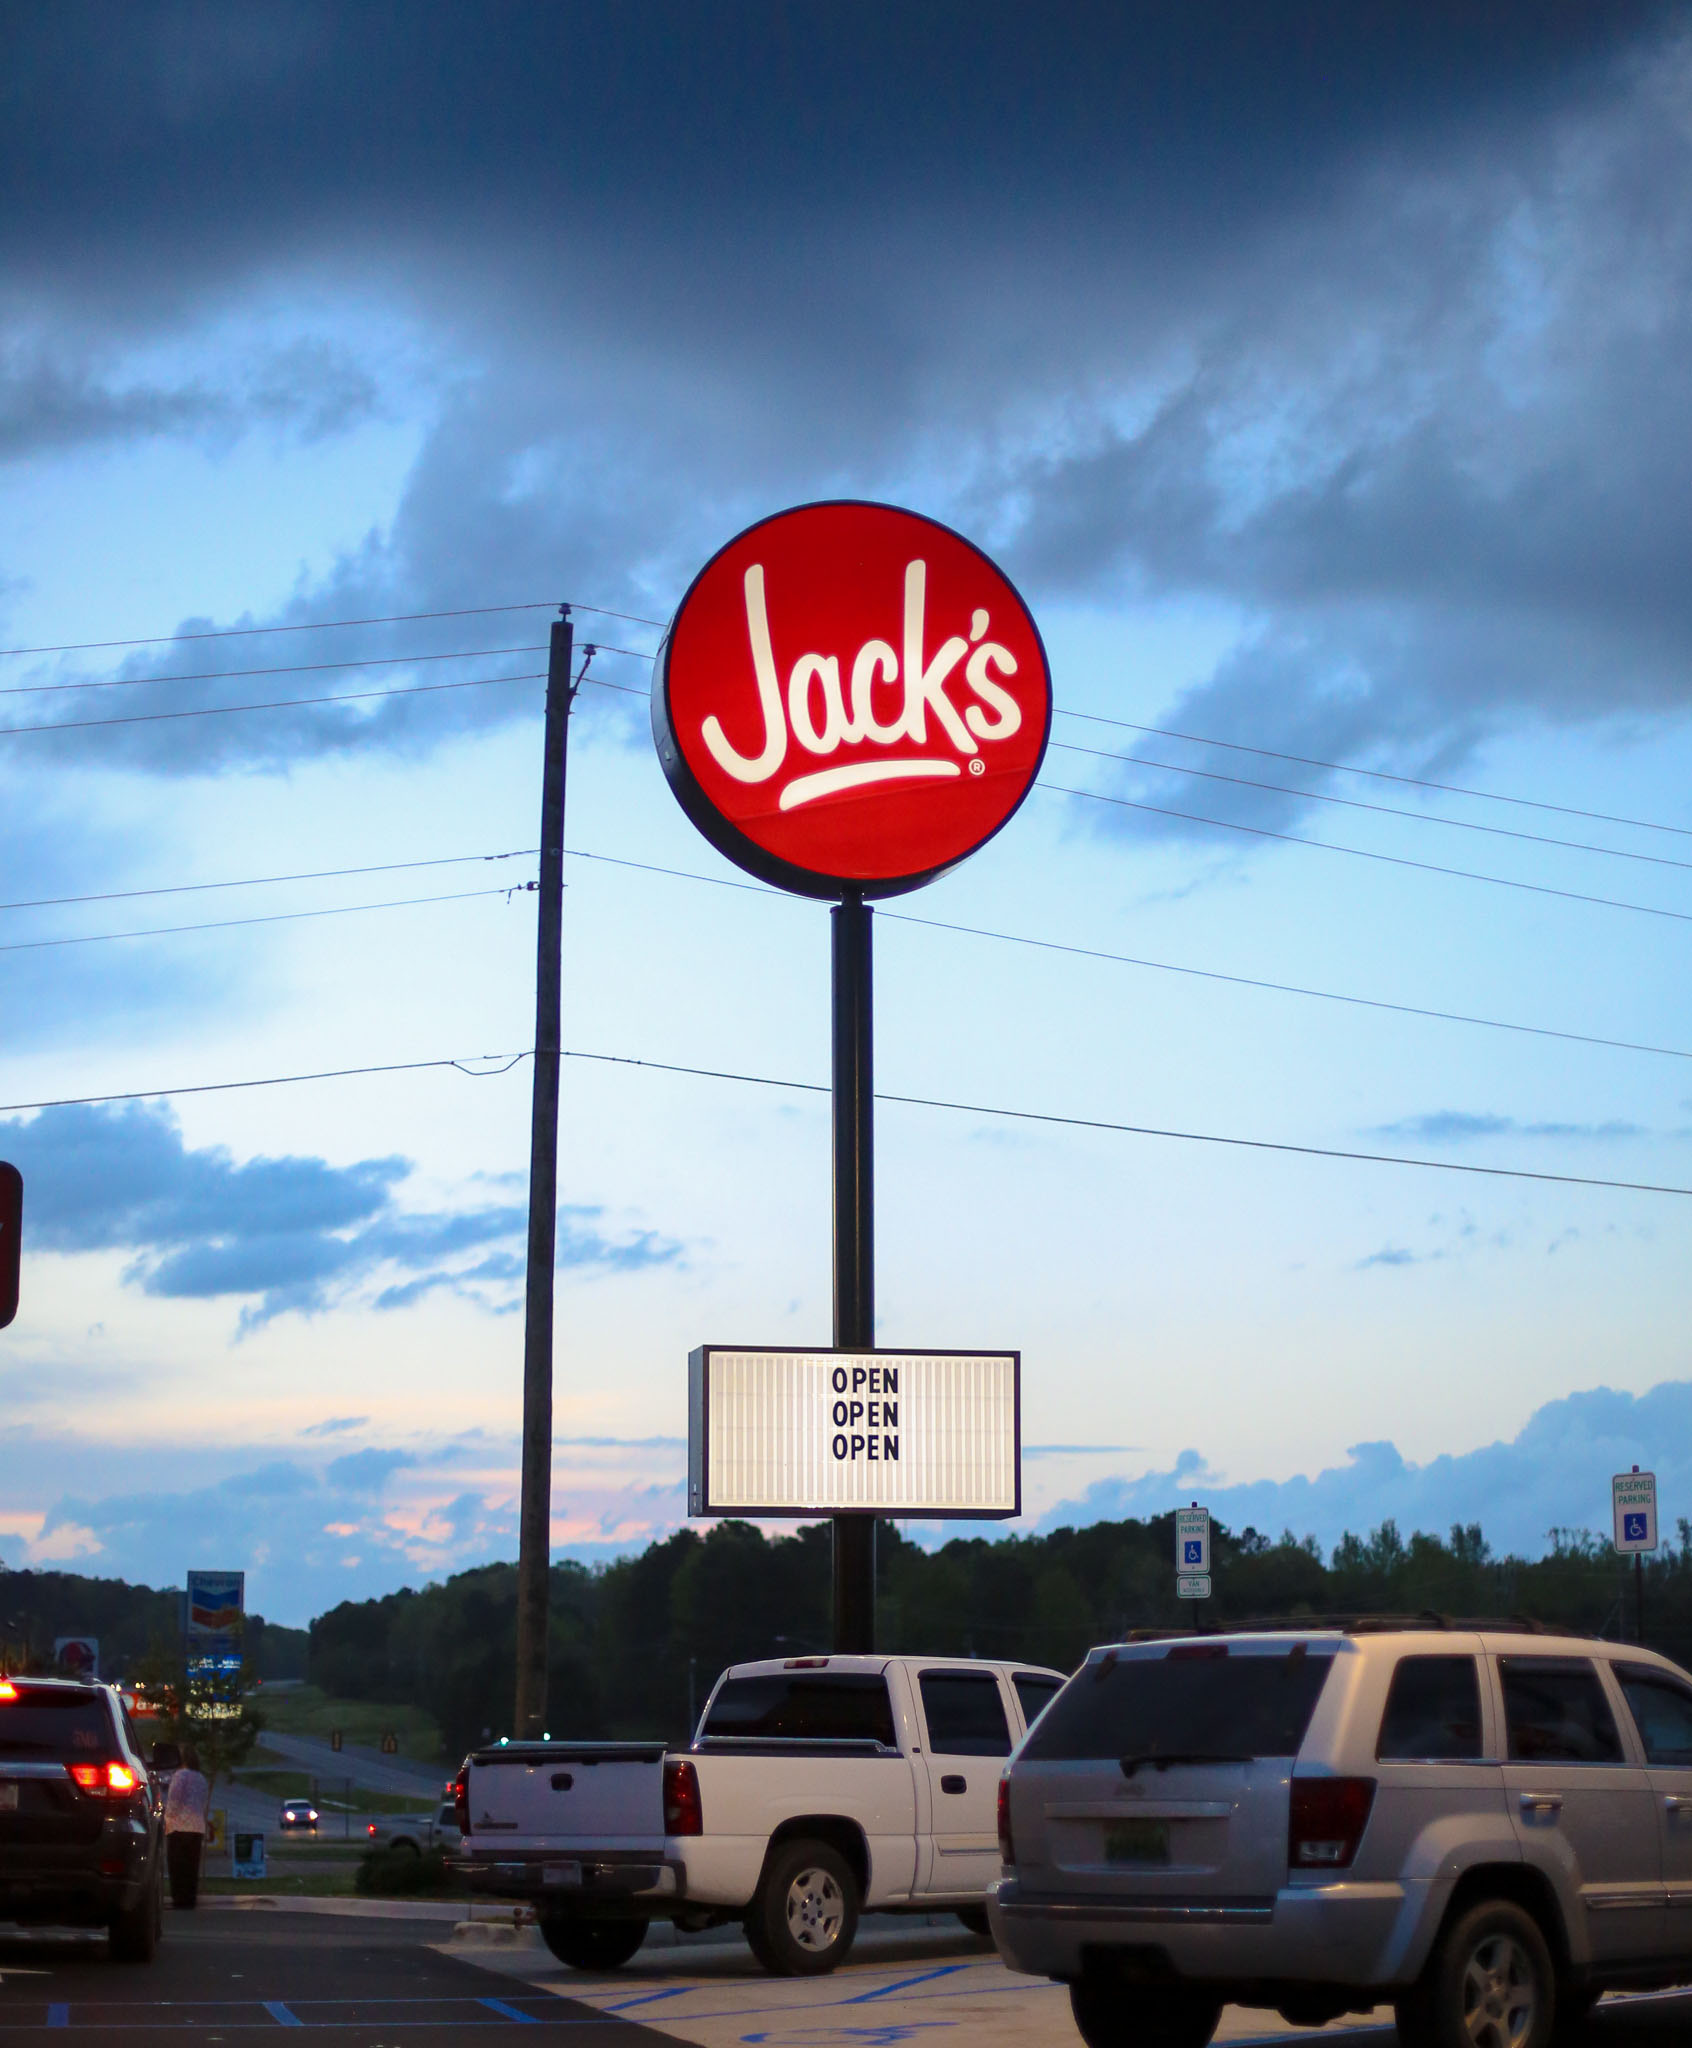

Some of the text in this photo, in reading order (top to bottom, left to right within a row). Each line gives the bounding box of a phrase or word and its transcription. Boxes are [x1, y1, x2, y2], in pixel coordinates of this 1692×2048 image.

[701, 559, 1022, 784] Jack's
[832, 1367, 899, 1393] OPEN
[832, 1401, 899, 1427] OPEN
[832, 1434, 899, 1461] OPEN
[1615, 1480, 1653, 1491] RESERVED
[1618, 1494, 1652, 1504] PARKING
[1178, 1513, 1207, 1523] RESERVED
[1180, 1525, 1205, 1535] PARKING
